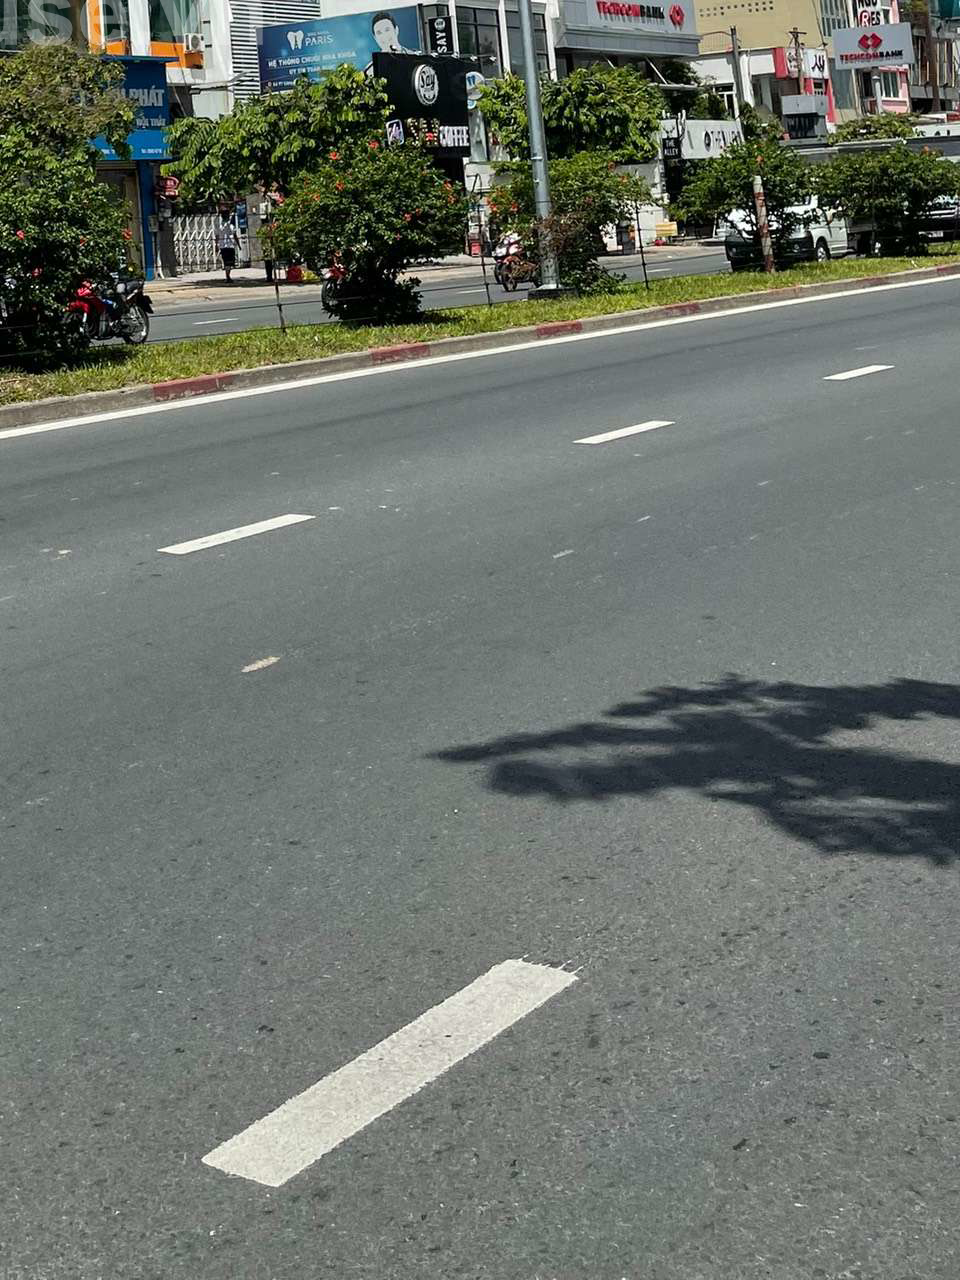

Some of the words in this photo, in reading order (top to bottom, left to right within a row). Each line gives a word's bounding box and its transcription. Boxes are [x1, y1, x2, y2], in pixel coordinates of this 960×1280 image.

[596, 0, 665, 20] TECHCOMBANK
[305, 34, 335, 47] PARIS
[436, 30, 448, 53] SAY
[839, 50, 904, 62] TECHCOMBANK
[665, 139, 675, 148] THE
[664, 148, 679, 156] ALLEY
